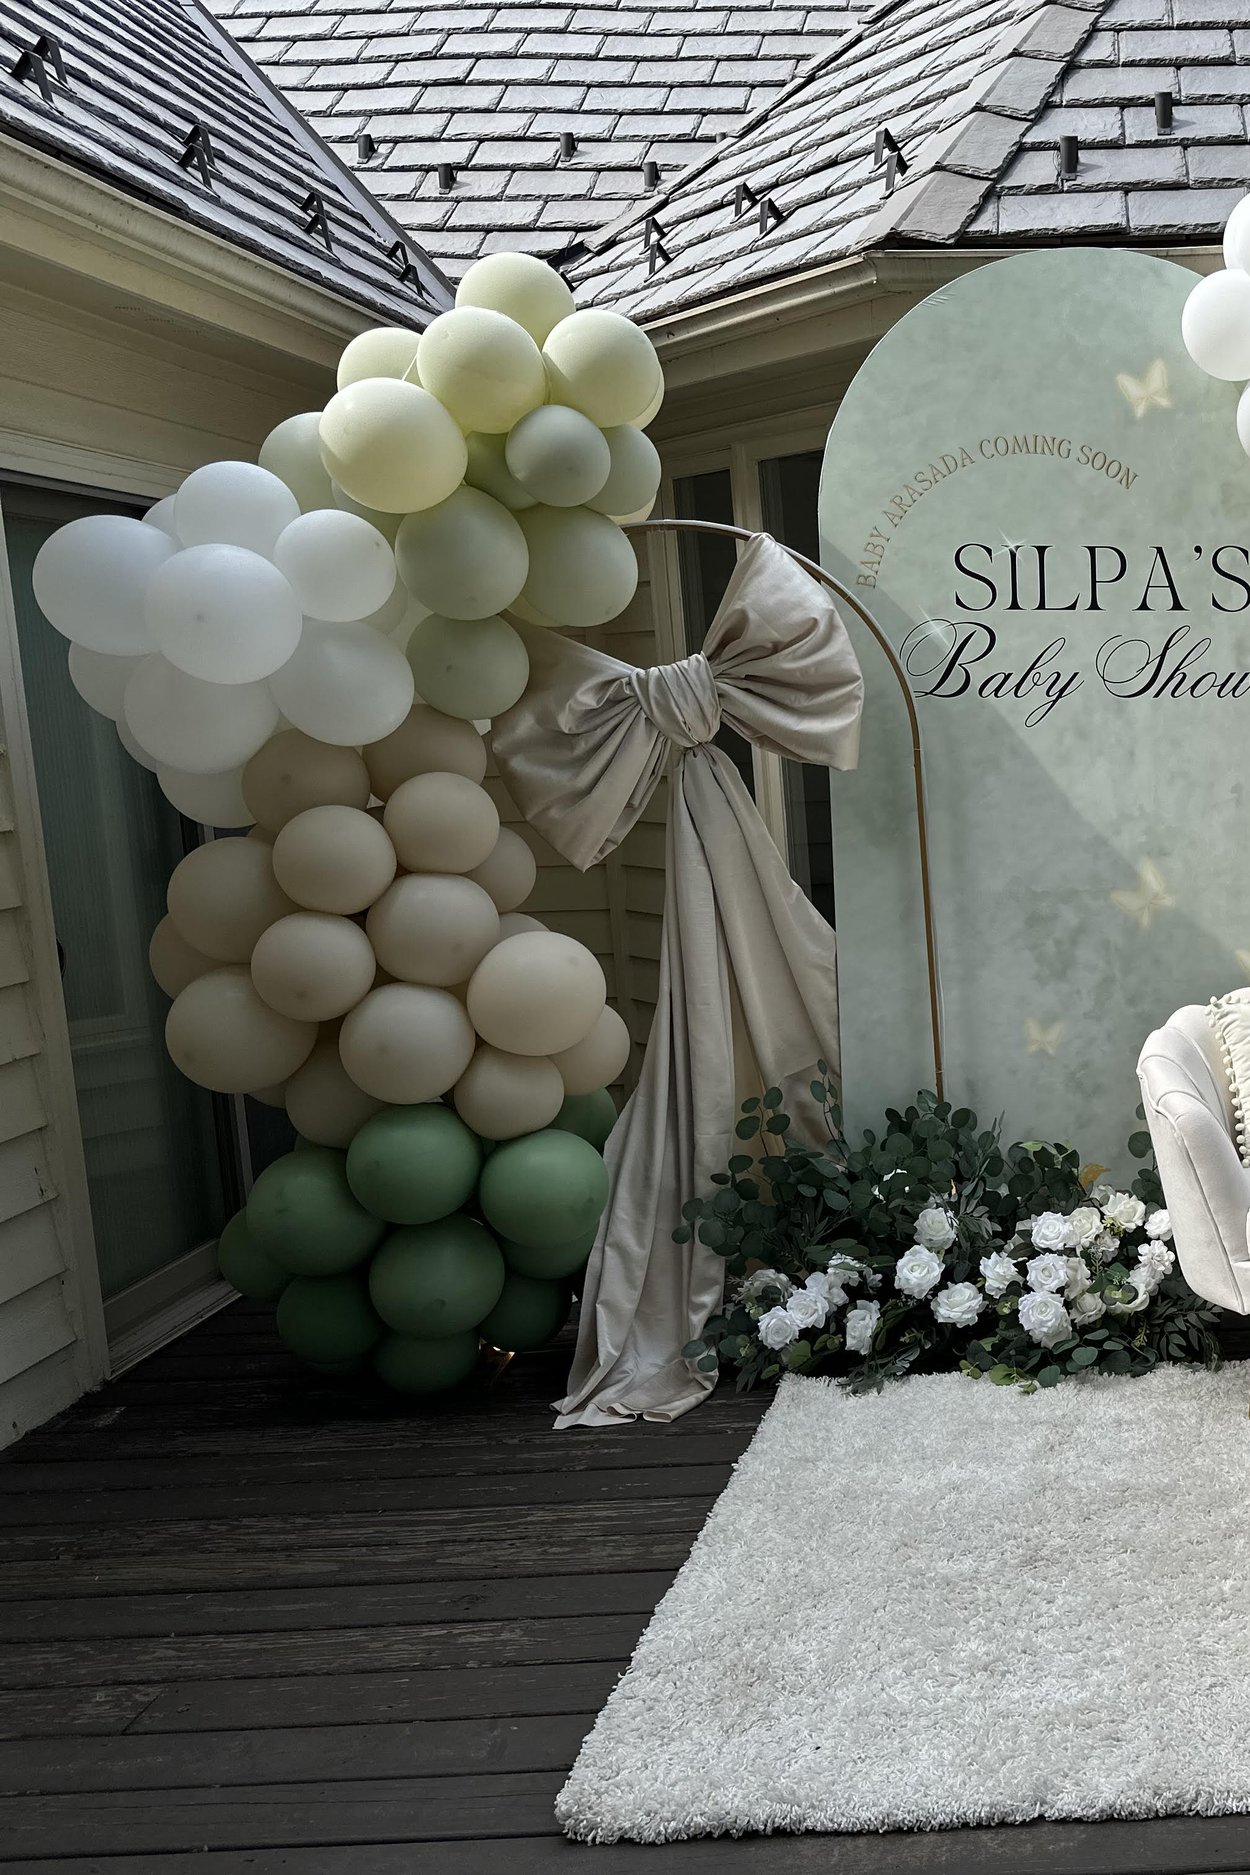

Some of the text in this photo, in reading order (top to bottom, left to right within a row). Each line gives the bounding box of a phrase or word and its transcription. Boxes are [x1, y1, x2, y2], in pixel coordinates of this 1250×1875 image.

[856, 435, 1139, 589] BABY ARASADA COMING SOON
[899, 618, 1085, 728] Baby
